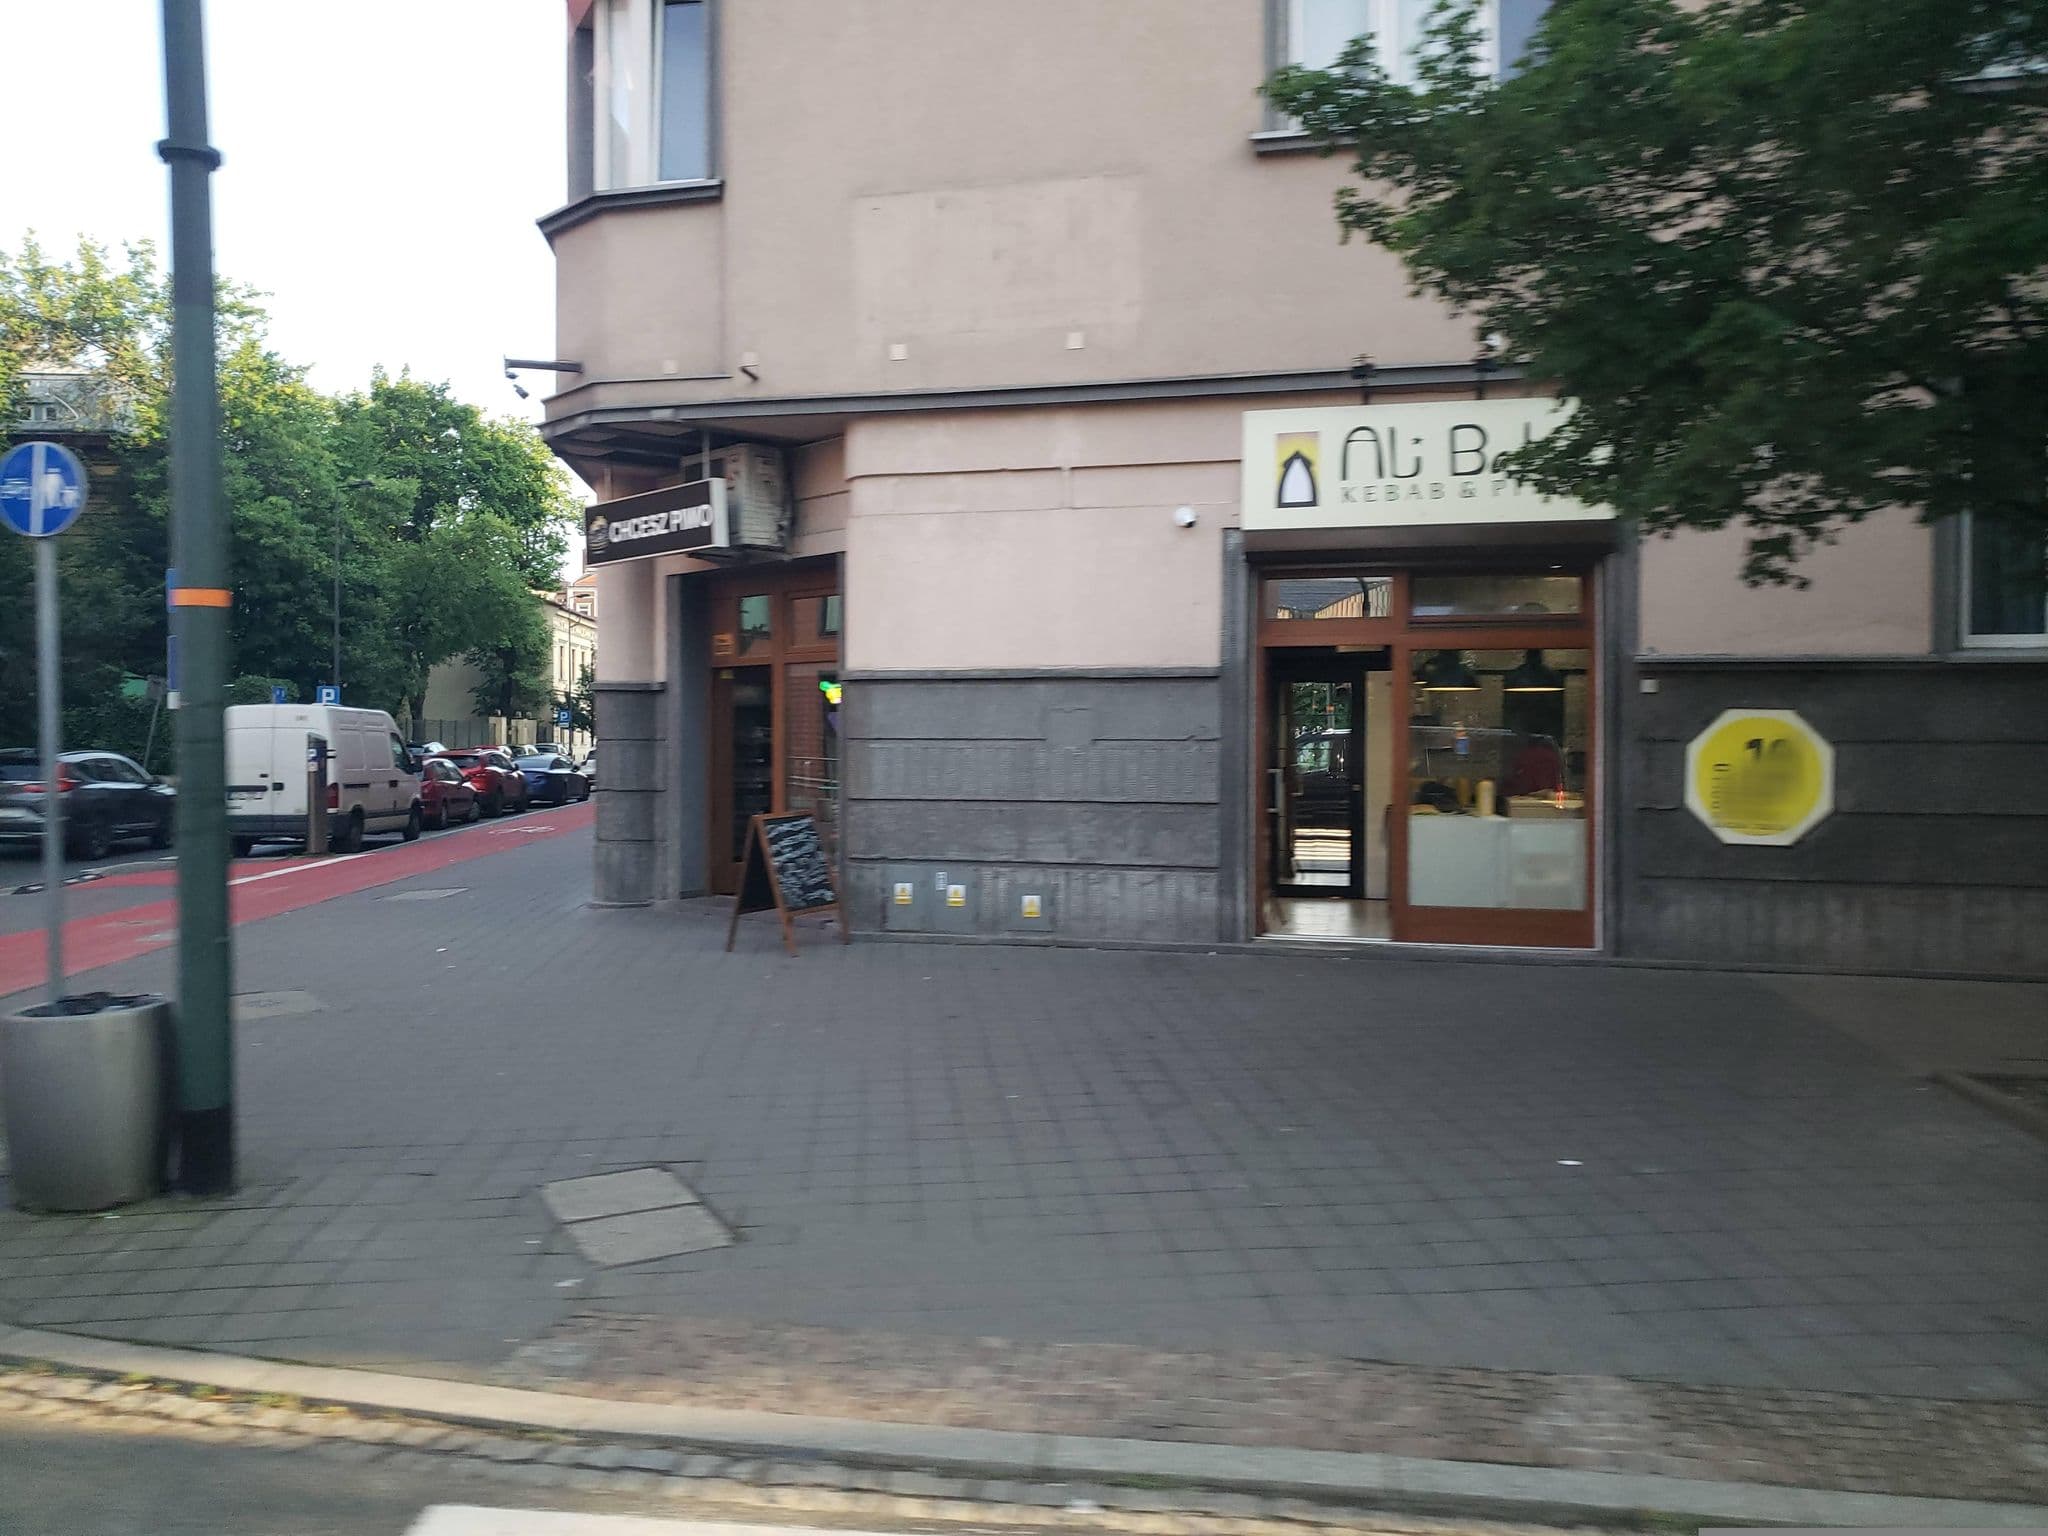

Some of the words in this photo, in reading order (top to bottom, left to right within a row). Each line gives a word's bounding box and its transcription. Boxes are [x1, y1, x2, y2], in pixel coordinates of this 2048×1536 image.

[1340, 482, 1446, 503] KEBAB
[1459, 481, 1475, 499] &
[322, 688, 335, 704] P
